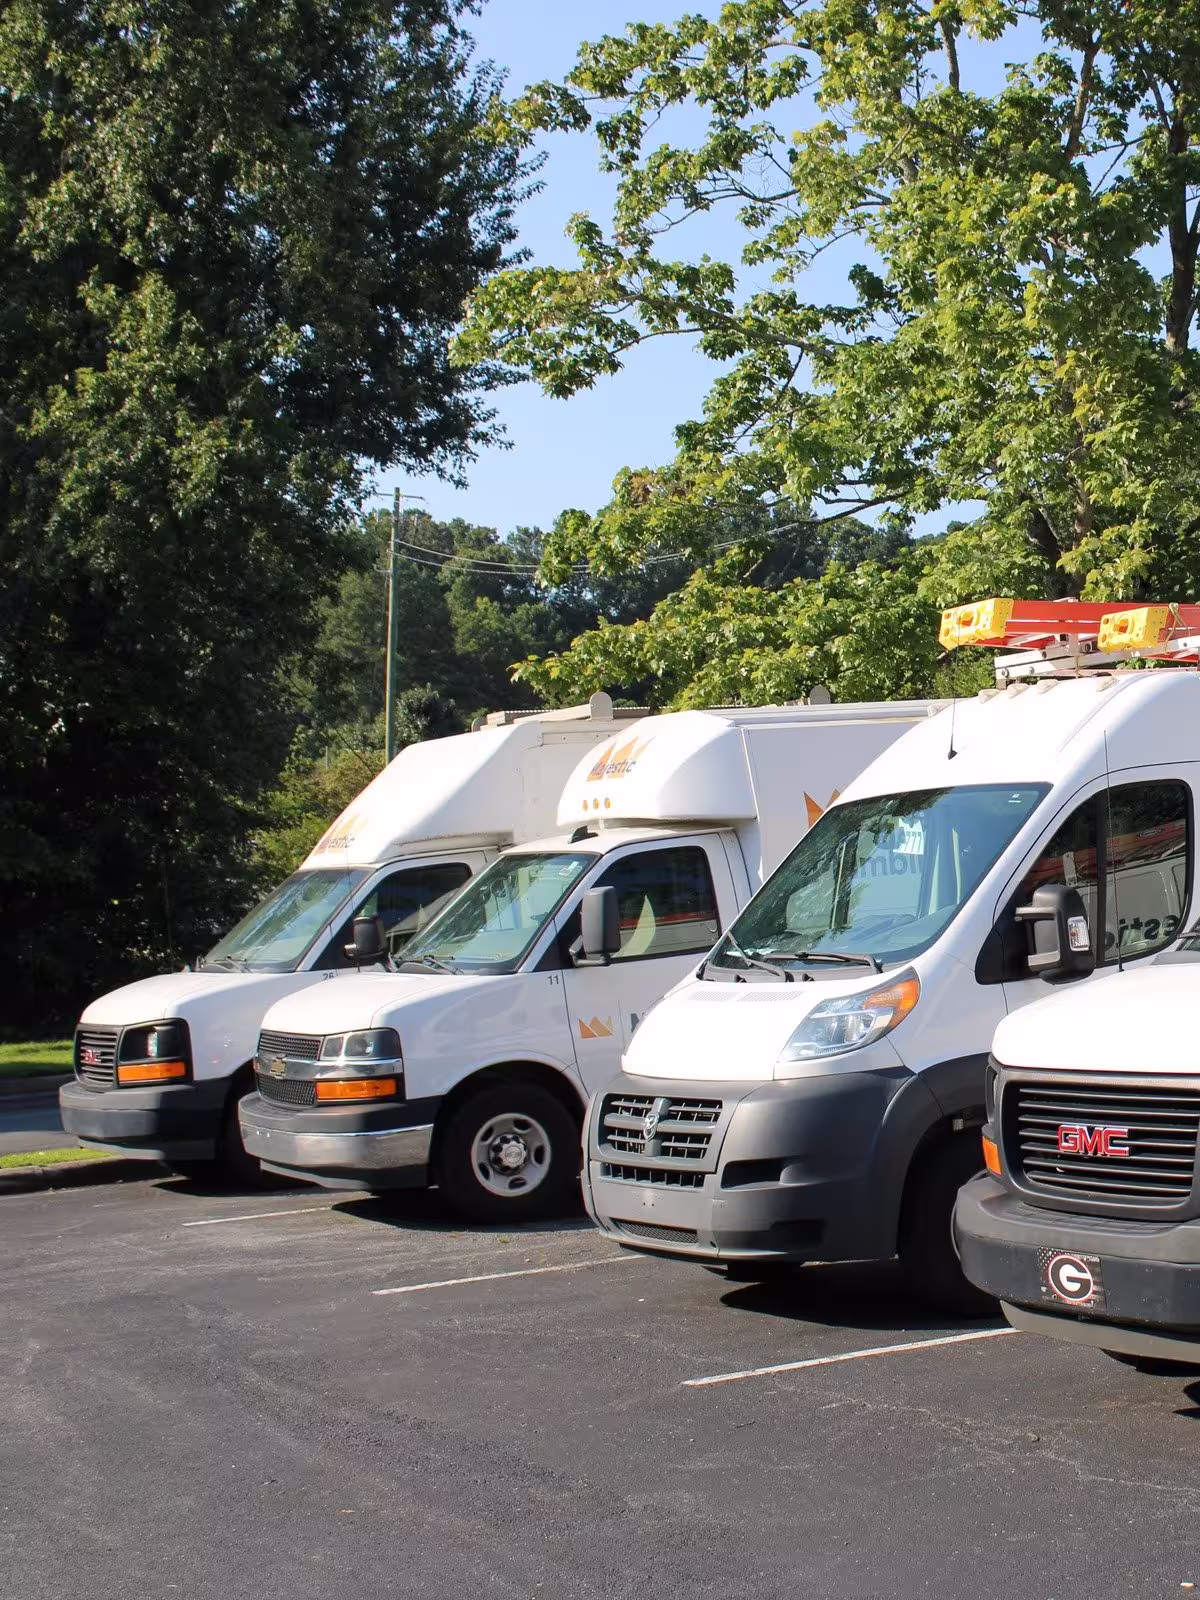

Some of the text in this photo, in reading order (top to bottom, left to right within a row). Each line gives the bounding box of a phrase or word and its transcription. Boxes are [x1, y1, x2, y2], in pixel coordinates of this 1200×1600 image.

[547, 975, 559, 985] 11
[1058, 1125, 1129, 1157] GMC
[1050, 1256, 1092, 1300] G
